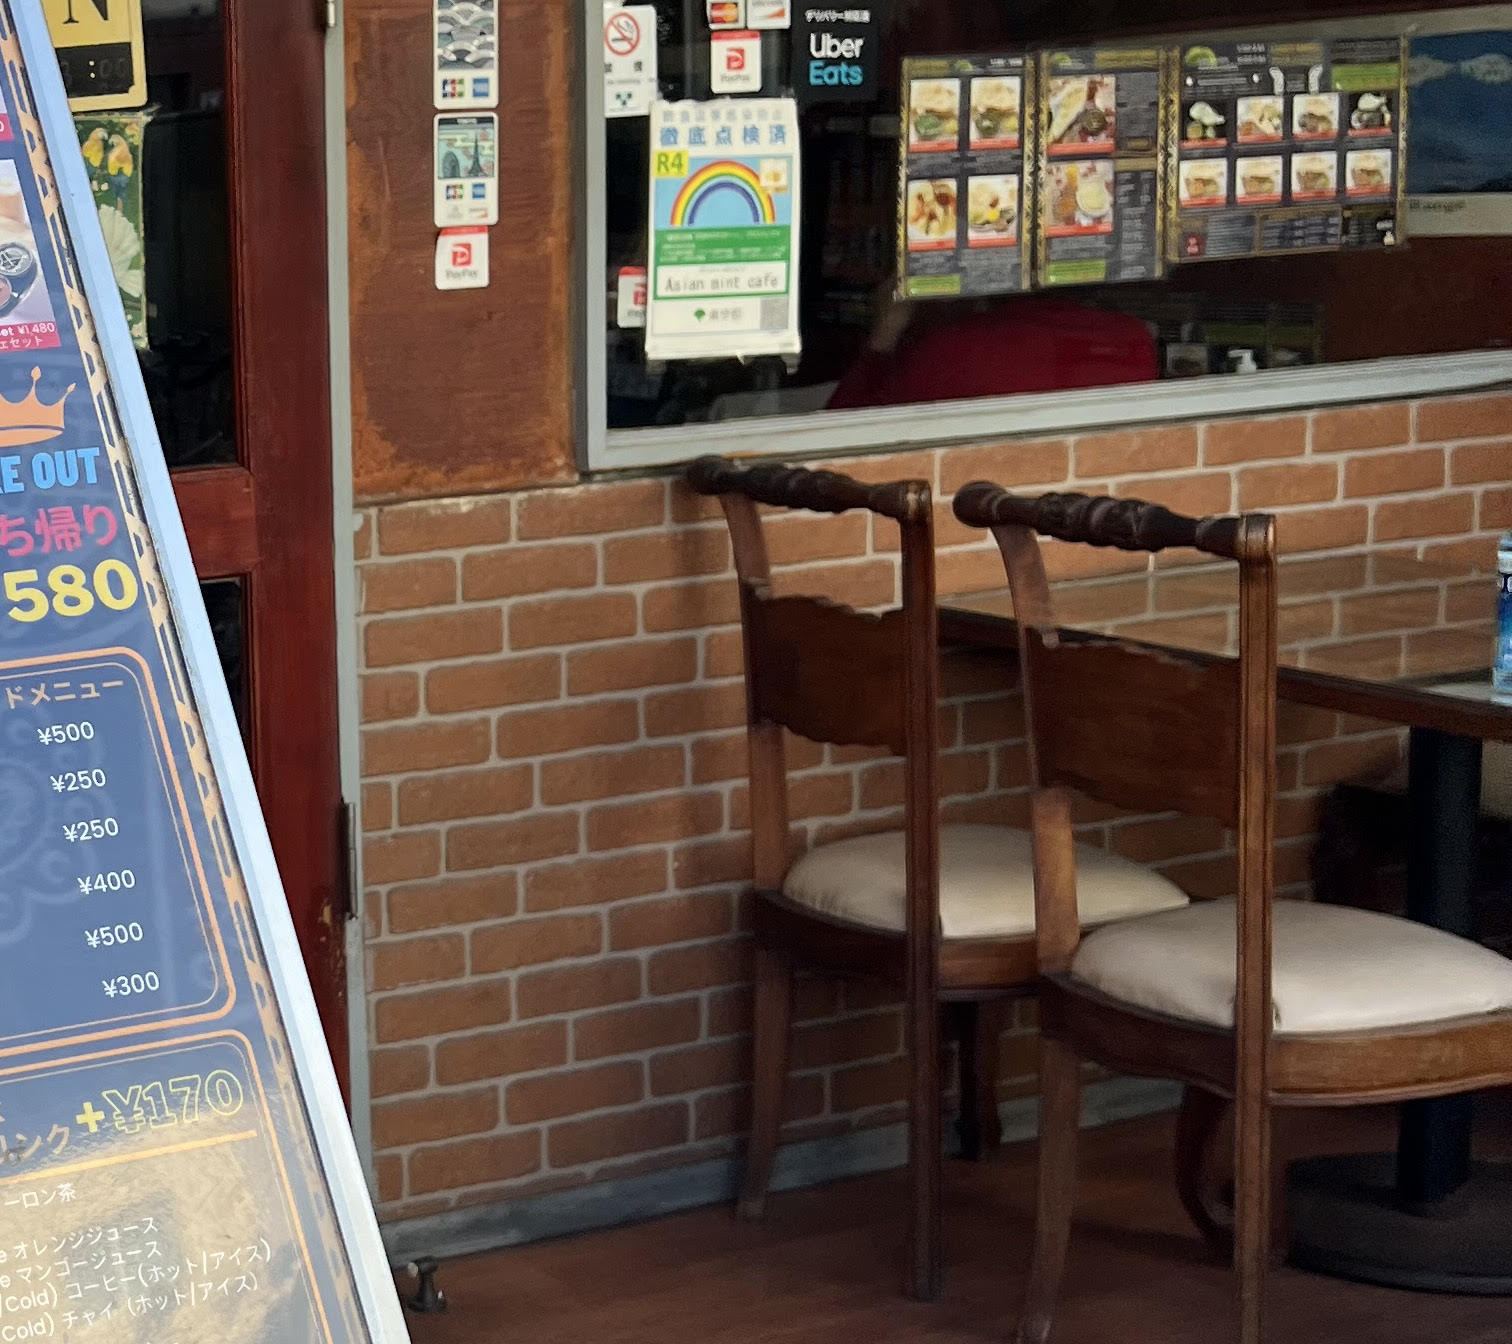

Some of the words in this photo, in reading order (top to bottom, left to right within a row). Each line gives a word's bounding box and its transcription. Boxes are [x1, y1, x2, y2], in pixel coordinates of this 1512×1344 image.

[810, 32, 864, 58] Uber
[809, 61, 863, 86] Eats
[657, 153, 685, 172] R4
[665, 279, 704, 292] Asian
[711, 278, 739, 288] mint
[748, 273, 778, 287] cafe
[33, 448, 100, 489] OUT
[37, 722, 95, 746] ¥500
[78, 870, 136, 895] ¥400
[102, 972, 159, 997] ¥300
